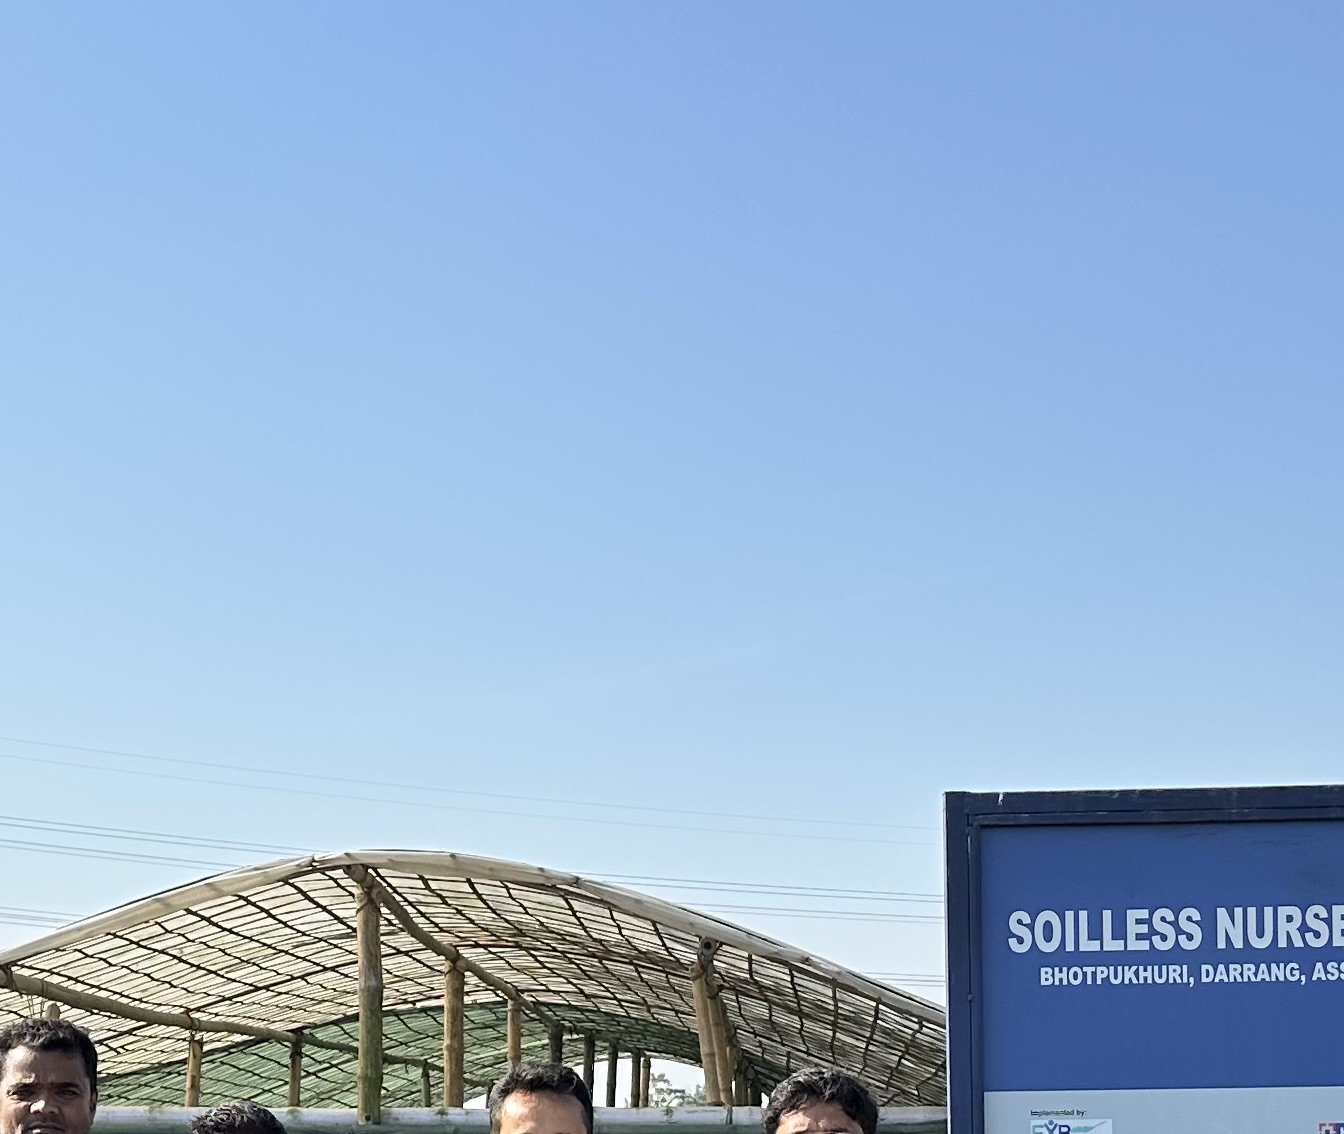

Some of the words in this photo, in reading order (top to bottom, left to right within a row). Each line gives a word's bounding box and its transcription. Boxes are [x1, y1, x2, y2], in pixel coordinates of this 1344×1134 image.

[1007, 908, 1203, 953] SOILLESS
[1039, 964, 1195, 988] BHOTPUKHURI,
[1200, 962, 1307, 985] DARRANG,
